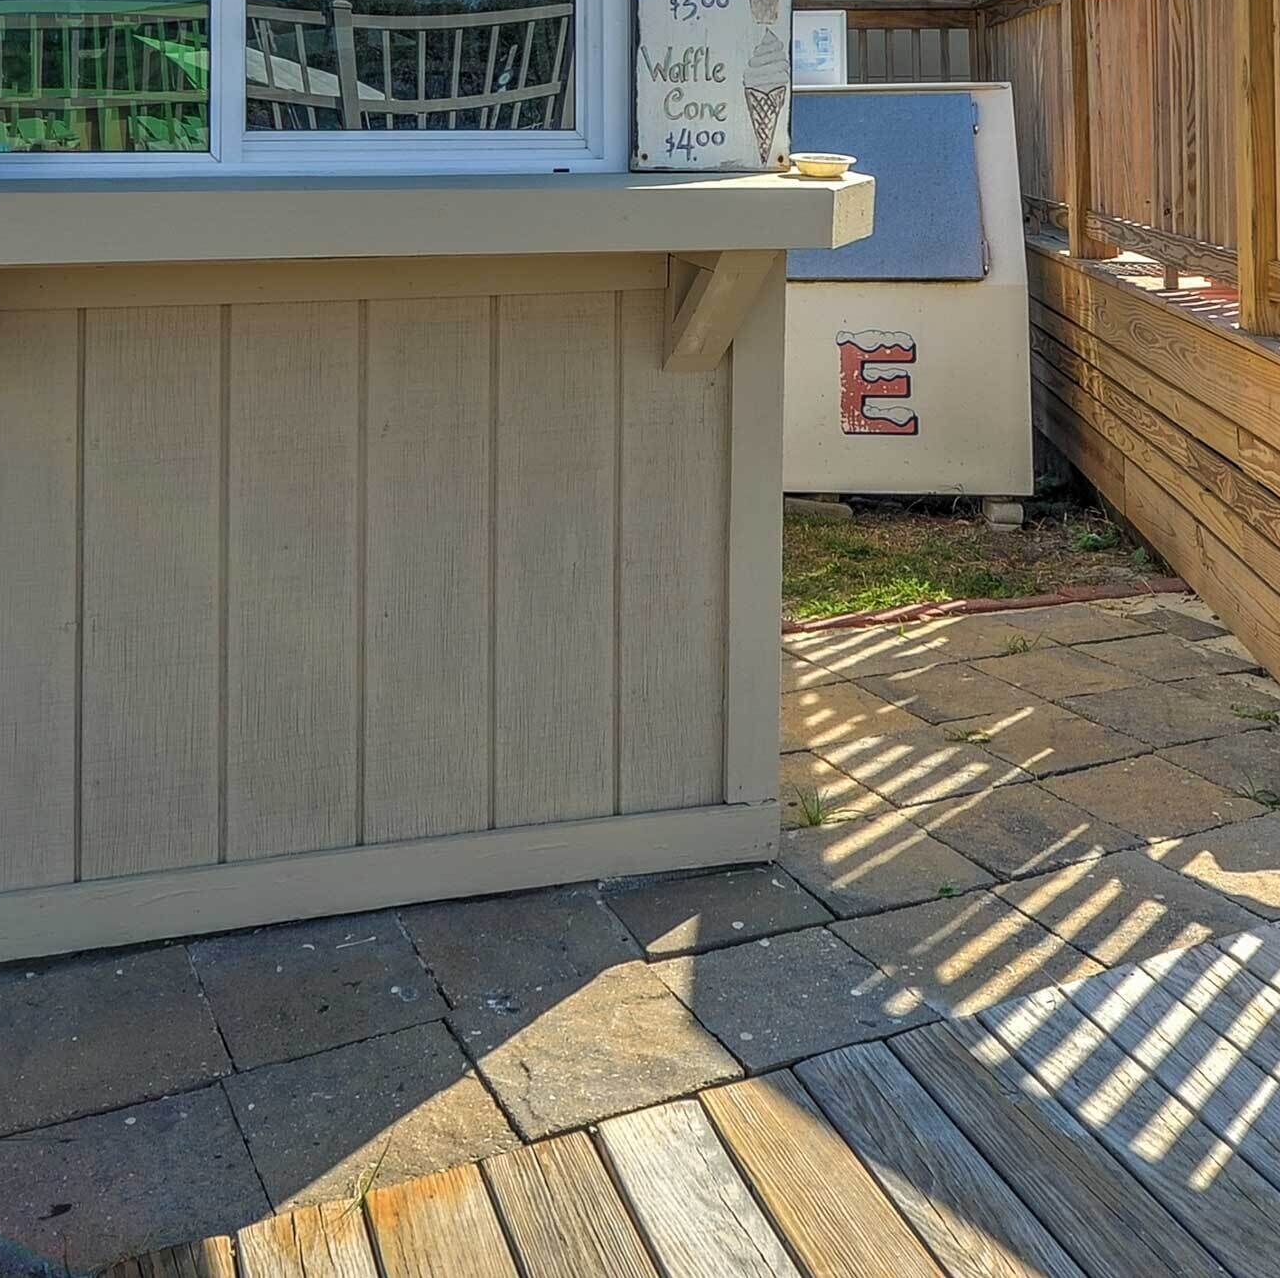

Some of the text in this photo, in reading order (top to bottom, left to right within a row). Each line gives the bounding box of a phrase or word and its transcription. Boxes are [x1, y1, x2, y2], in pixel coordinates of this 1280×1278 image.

[641, 44, 727, 85] Waffle
[663, 87, 728, 123] Cone
[836, 329, 918, 436] E
